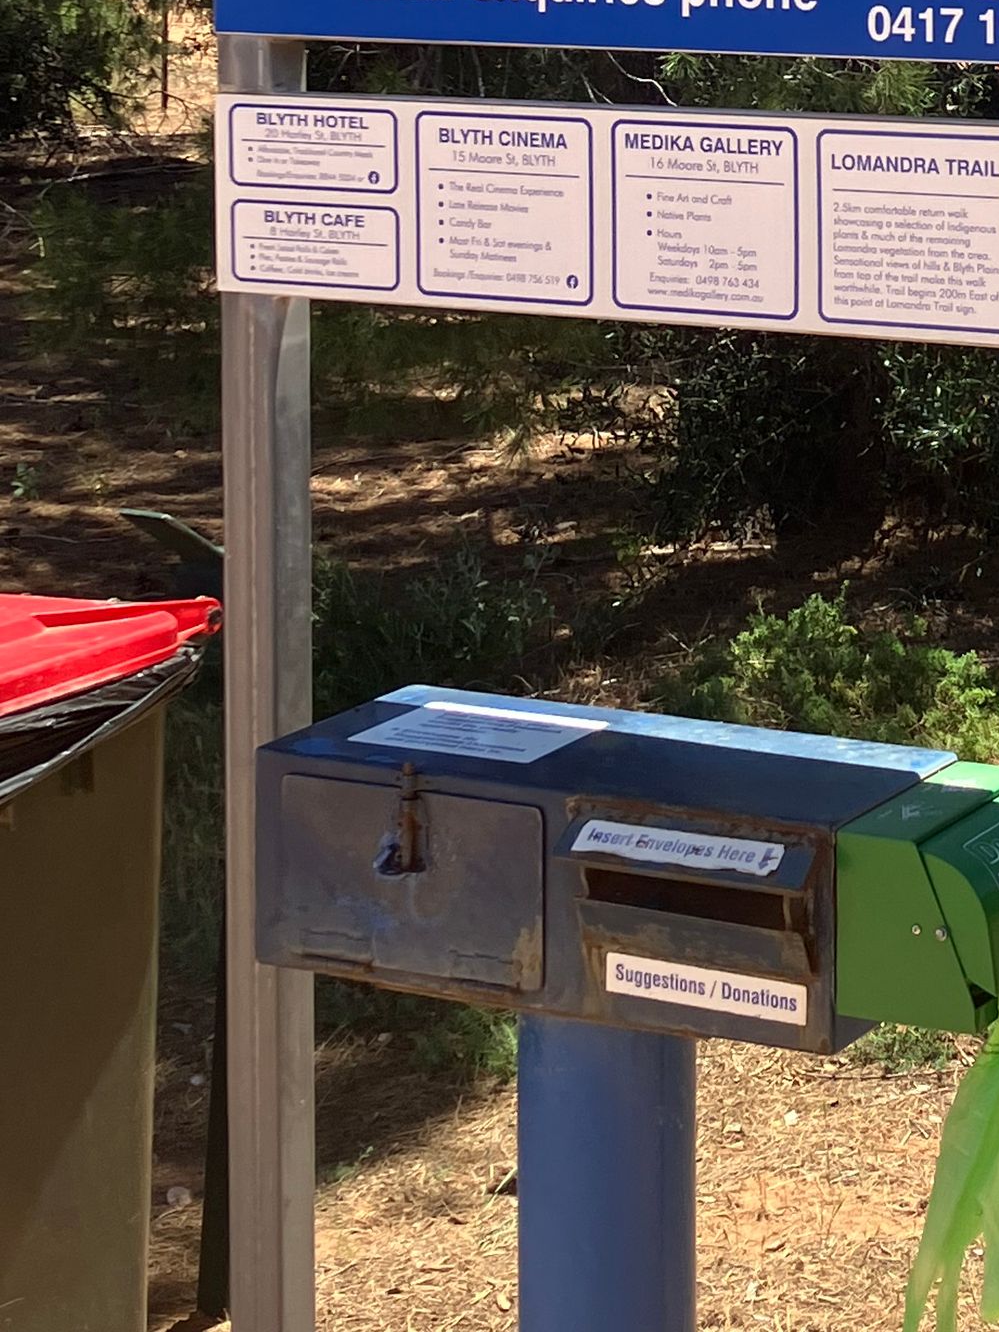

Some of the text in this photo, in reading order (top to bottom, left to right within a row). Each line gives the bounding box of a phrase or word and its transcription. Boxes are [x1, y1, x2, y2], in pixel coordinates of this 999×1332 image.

[868, 6, 963, 43] 0417
[256, 112, 369, 130] BLYTH HOTEL
[439, 127, 568, 149] BLYTH CINEMA
[625, 133, 783, 156] MEDIKA GALLERY
[651, 156, 664, 169] 16
[667, 158, 703, 171] Moore
[723, 160, 759, 174] BLYTH
[831, 154, 940, 175] LOMANDRA
[264, 210, 365, 228] BLYTH CAFE
[587, 828, 756, 863] Insert Envelopes Here
[616, 964, 797, 1011] Suggestions / Donations
